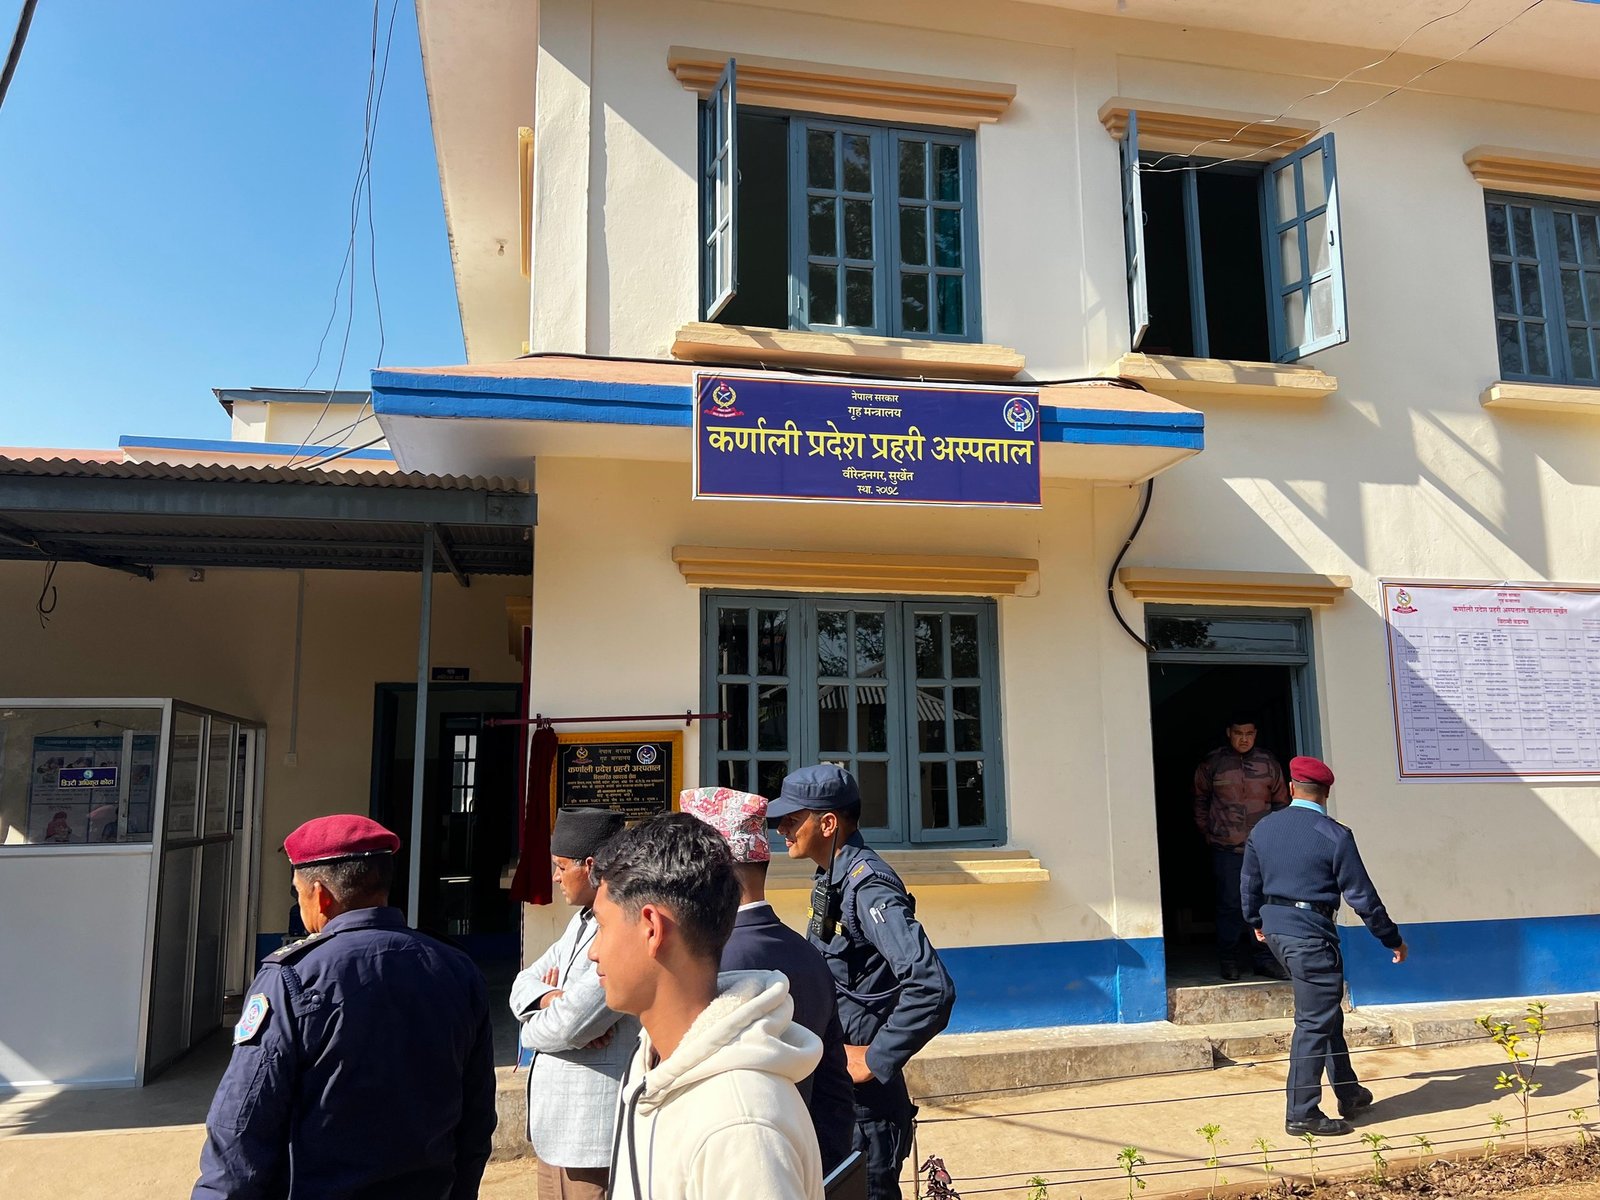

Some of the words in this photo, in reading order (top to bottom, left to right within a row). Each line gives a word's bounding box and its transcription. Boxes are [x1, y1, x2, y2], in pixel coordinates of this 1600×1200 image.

[851, 390, 873, 401] नेपाल
[874, 393, 899, 403] सरकार
[848, 406, 862, 420] गृह
[706, 416, 803, 456] कर्णाली
[805, 420, 867, 461] प्रदेश
[869, 425, 926, 464] प्रहरी
[930, 436, 1035, 465] अस्पताल
[842, 466, 887, 482] वीरेन्द्रनगर,
[888, 468, 914, 485] सुर्खेत
[856, 485, 873, 495] स्था.
[875, 485, 899, 496] २०७८
[568, 764, 593, 773] कर्णाली
[595, 764, 611, 773] प्रदेश
[613, 764, 630, 772] प्रहरी
